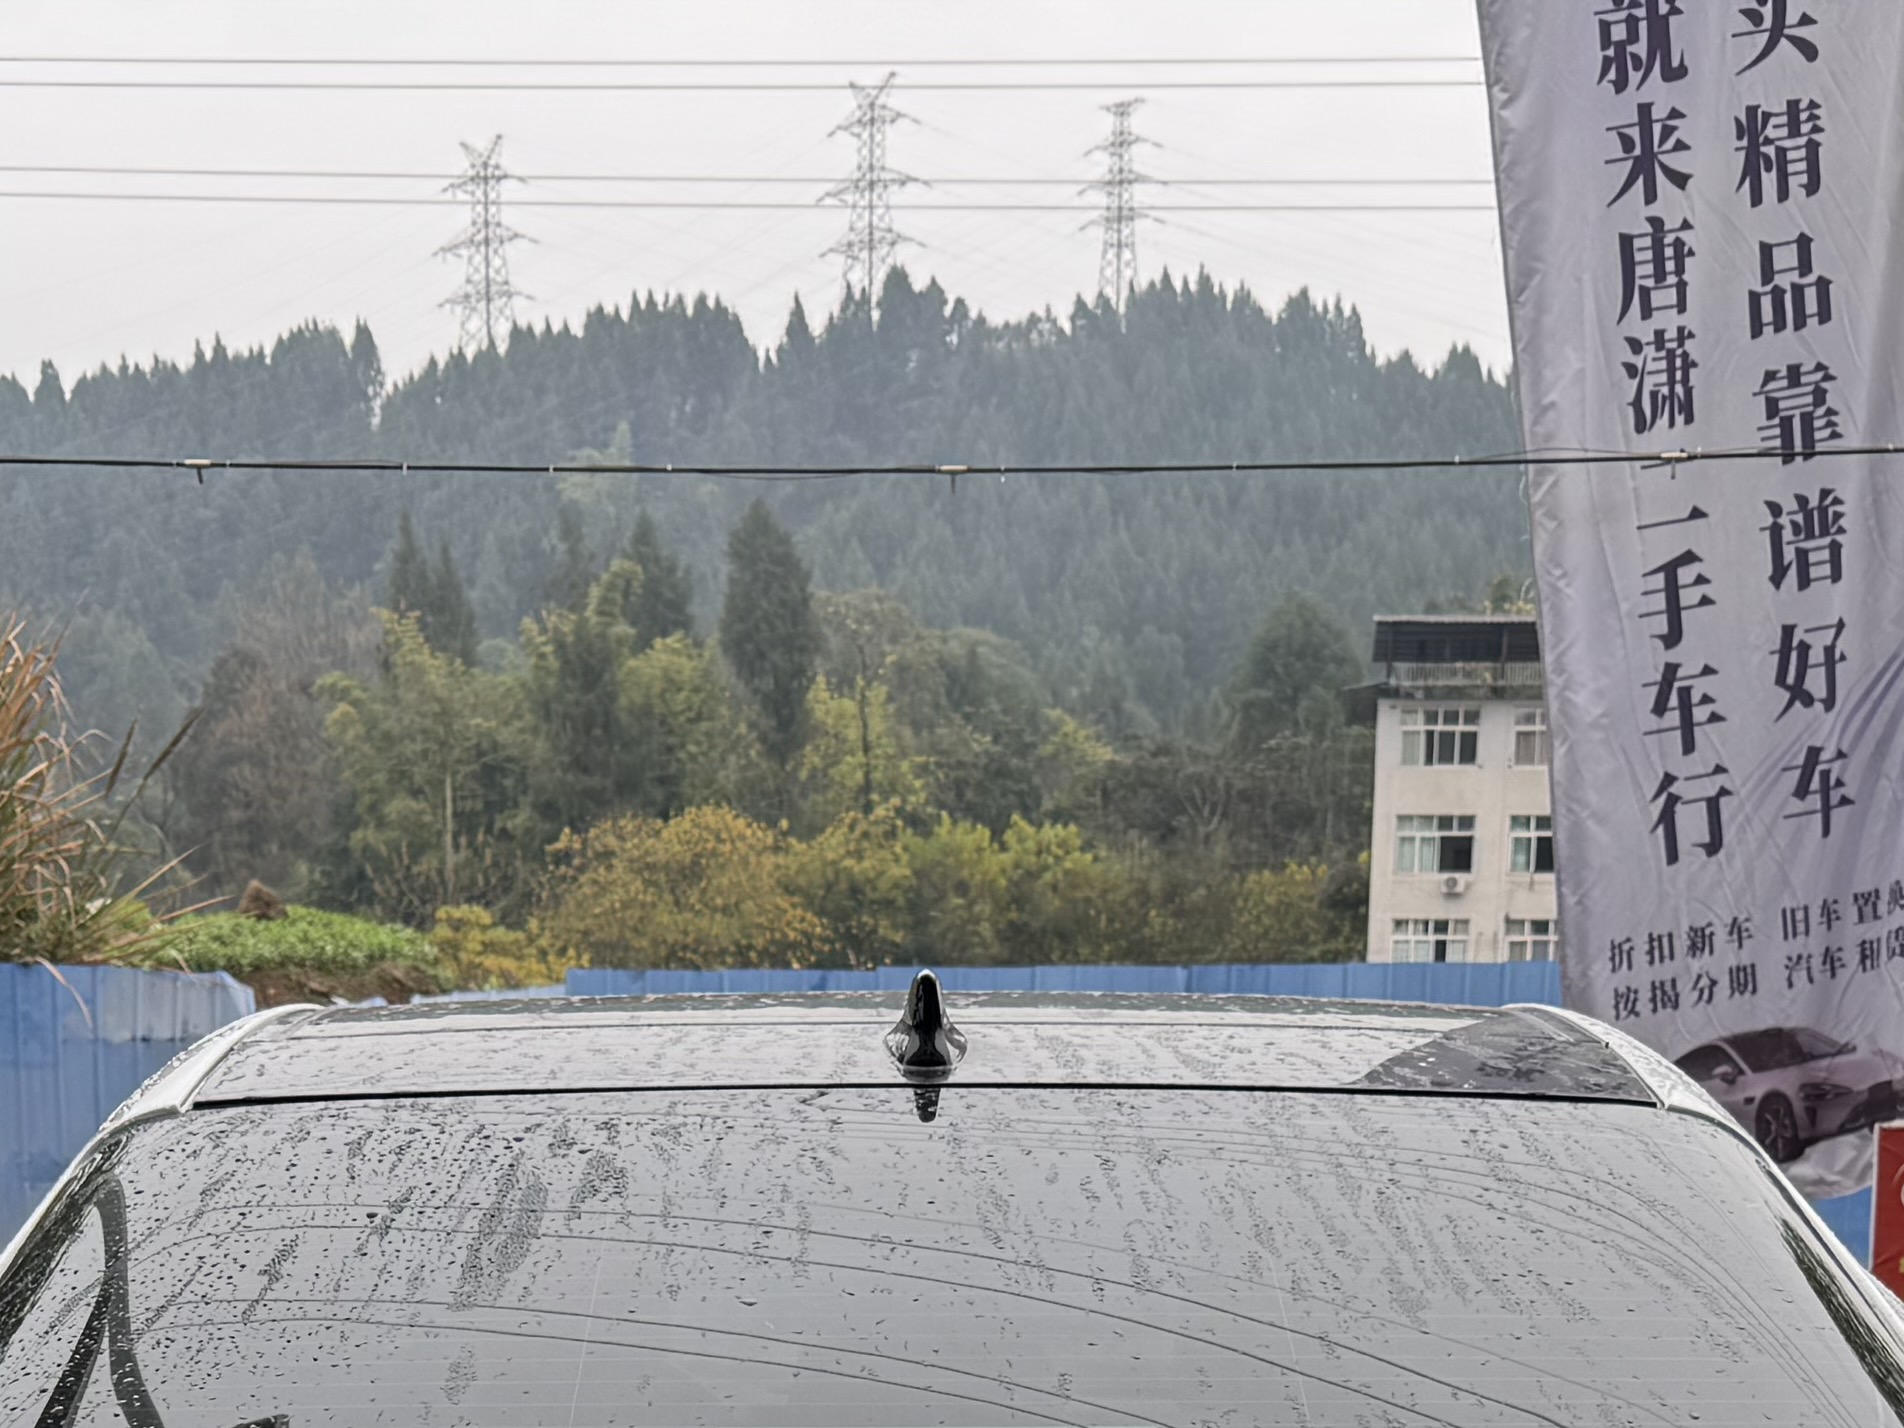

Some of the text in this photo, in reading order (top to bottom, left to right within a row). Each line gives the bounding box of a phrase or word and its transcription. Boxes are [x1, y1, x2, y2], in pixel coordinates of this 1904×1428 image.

[1608, 915, 1753, 973] 折扣新车
[1613, 963, 1758, 1021] 按揭分期
